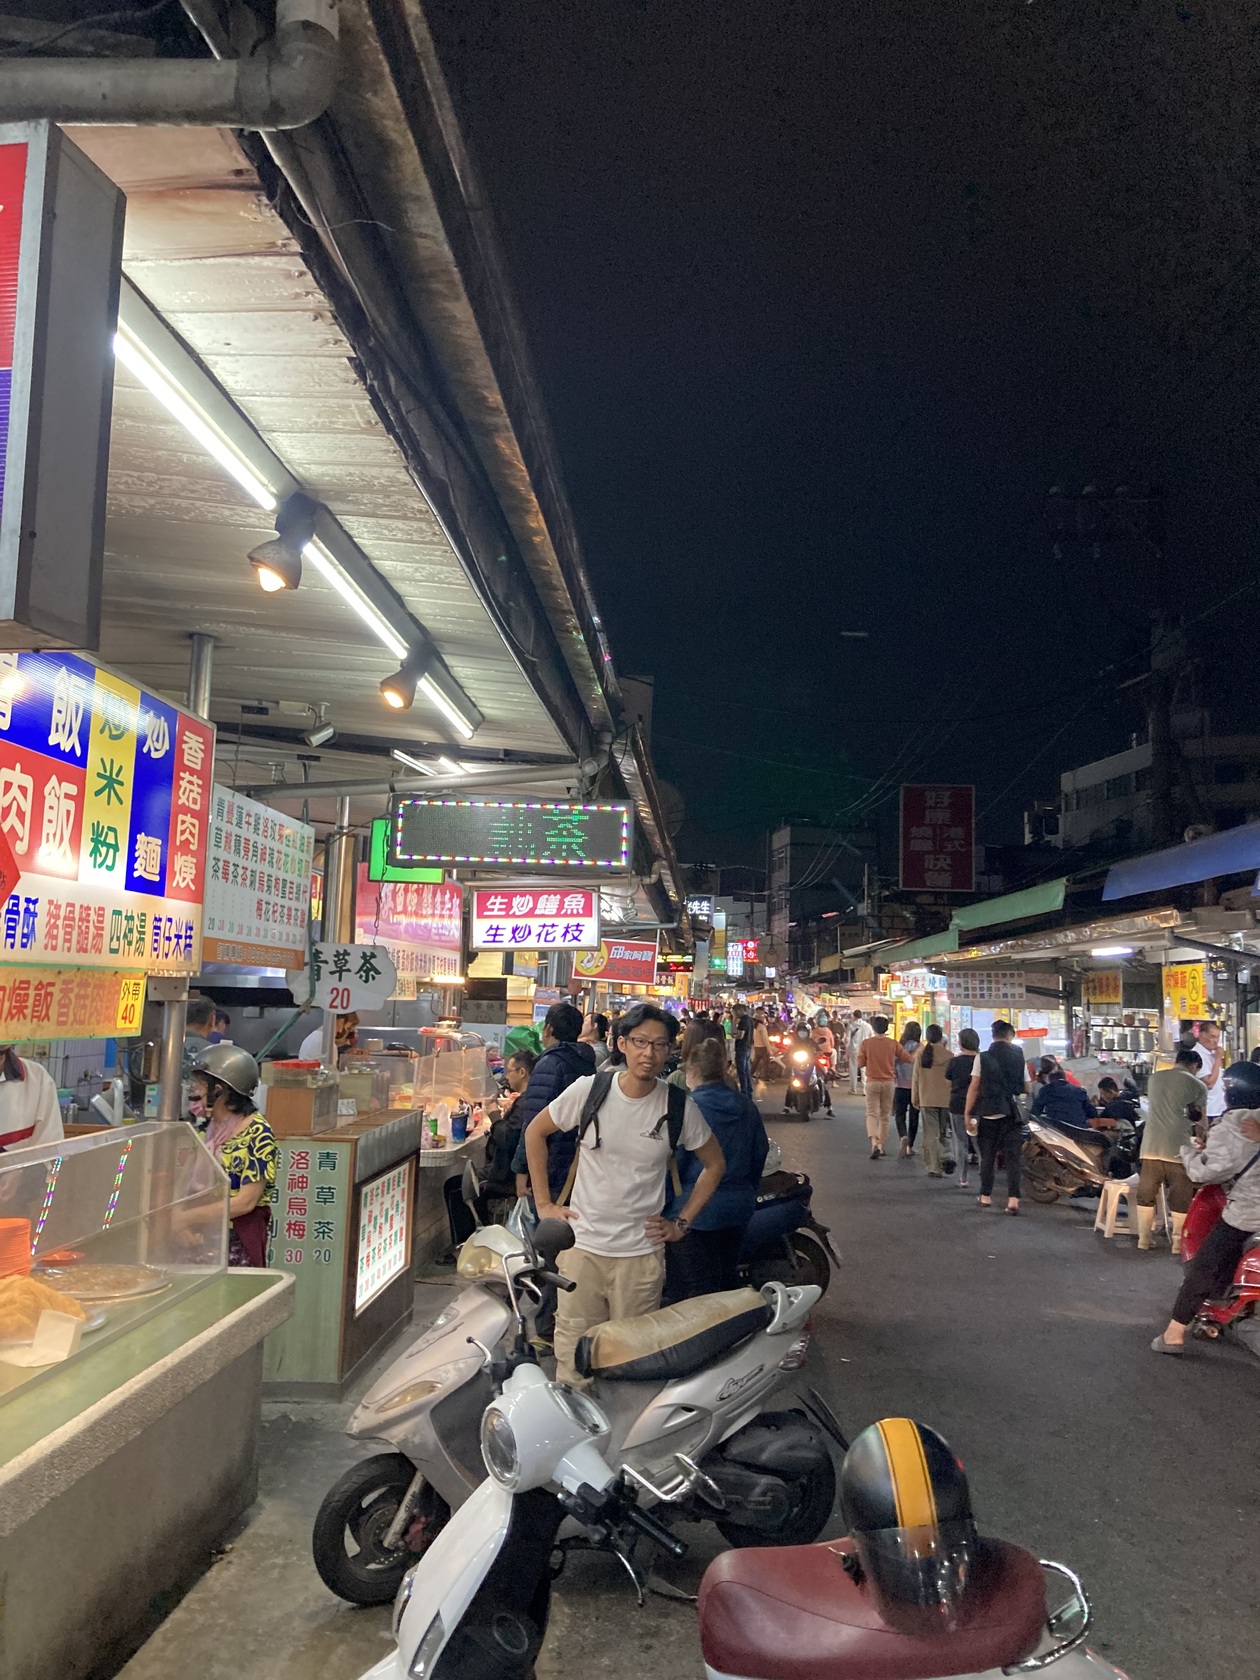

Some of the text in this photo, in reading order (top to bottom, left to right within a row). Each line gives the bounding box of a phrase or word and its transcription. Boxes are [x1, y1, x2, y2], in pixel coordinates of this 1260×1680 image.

[90, 690, 131, 872] 炒米粉
[132, 709, 171, 882] 炒麵
[211, 797, 225, 881] 青草茶
[482, 894, 586, 916] 生炒鱔魚
[109, 909, 147, 957] 四神湯
[150, 914, 194, 961] 筒仔米糕
[481, 922, 586, 943] 生炒花枝
[305, 947, 383, 985] 青草茶
[121, 982, 141, 1001] 外帶
[121, 1004, 135, 1025] 40
[329, 986, 351, 1010] 20
[285, 1150, 310, 1264] 洛神烏梅 30
[313, 1152, 338, 1241] 青草茶
